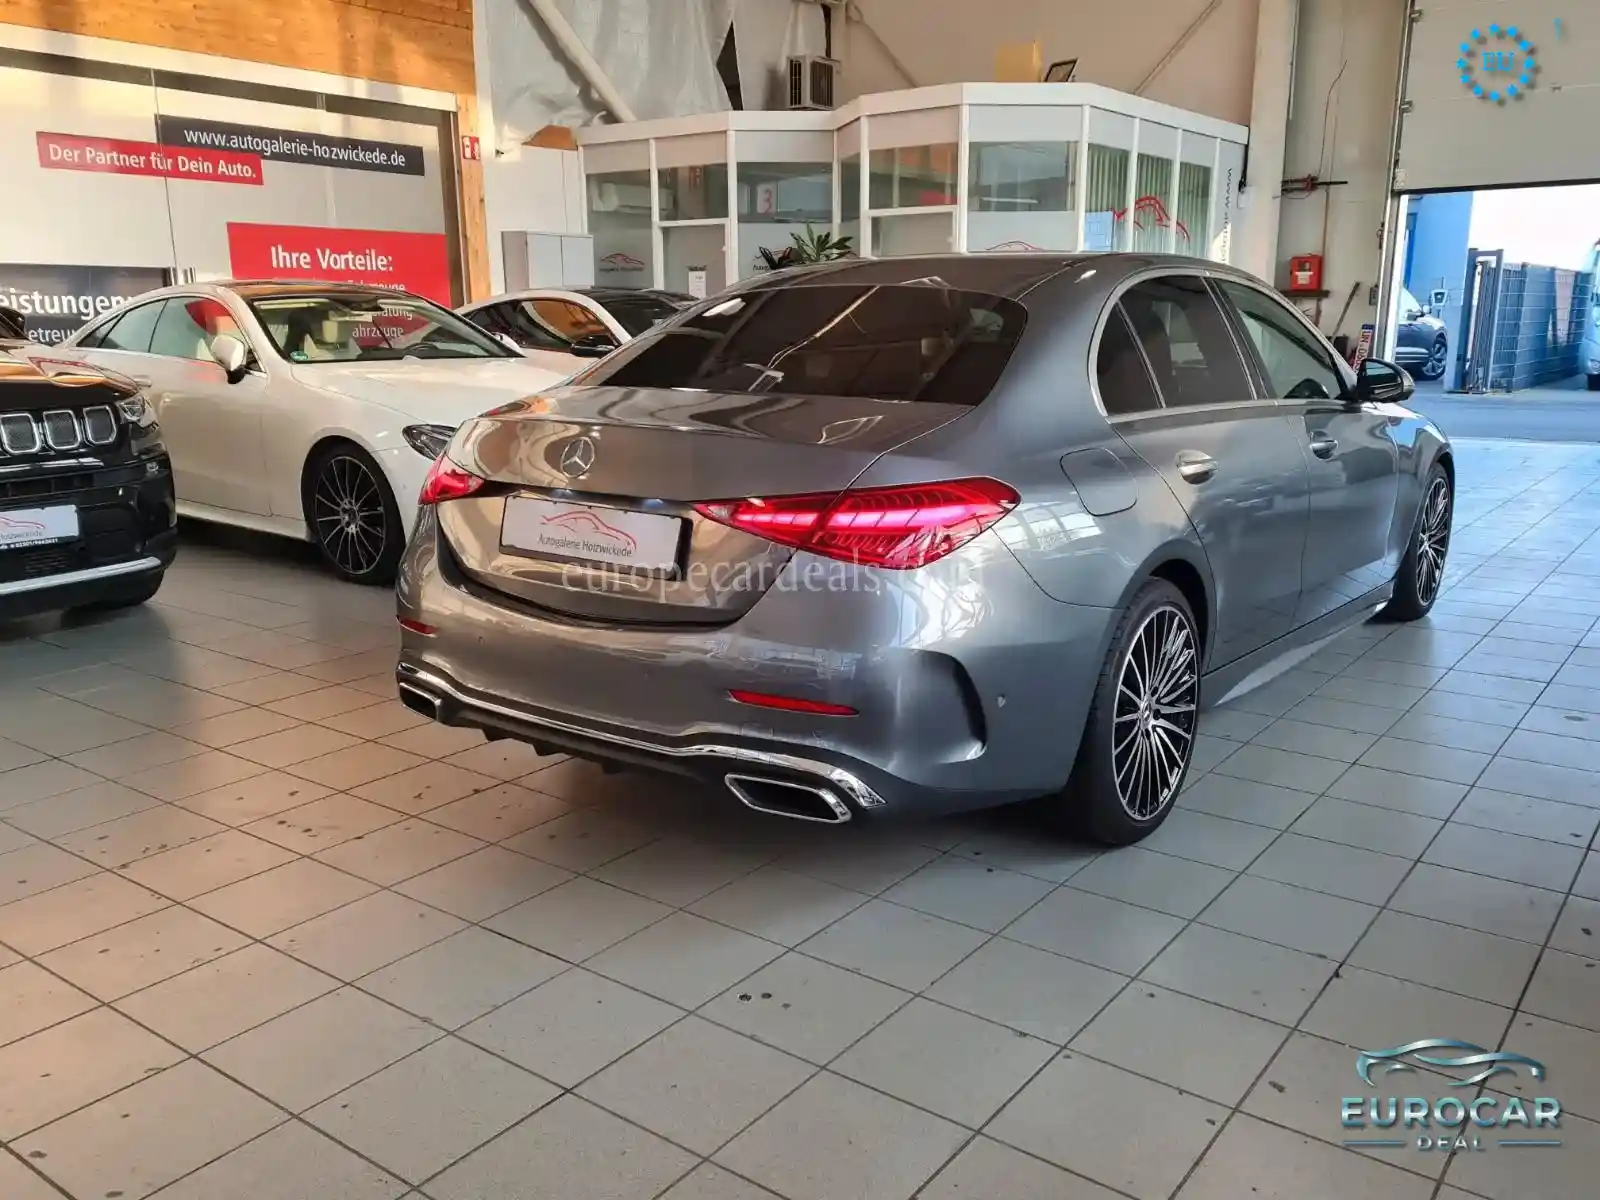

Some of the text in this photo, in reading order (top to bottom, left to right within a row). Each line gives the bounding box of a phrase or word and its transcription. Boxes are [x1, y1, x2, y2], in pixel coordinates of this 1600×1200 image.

[49, 143, 256, 178] Der Partner für Dein Auto.
[184, 129, 406, 167] www.autogalerie-hozwickede.de
[270, 244, 393, 271] Ihre Vorteile:
